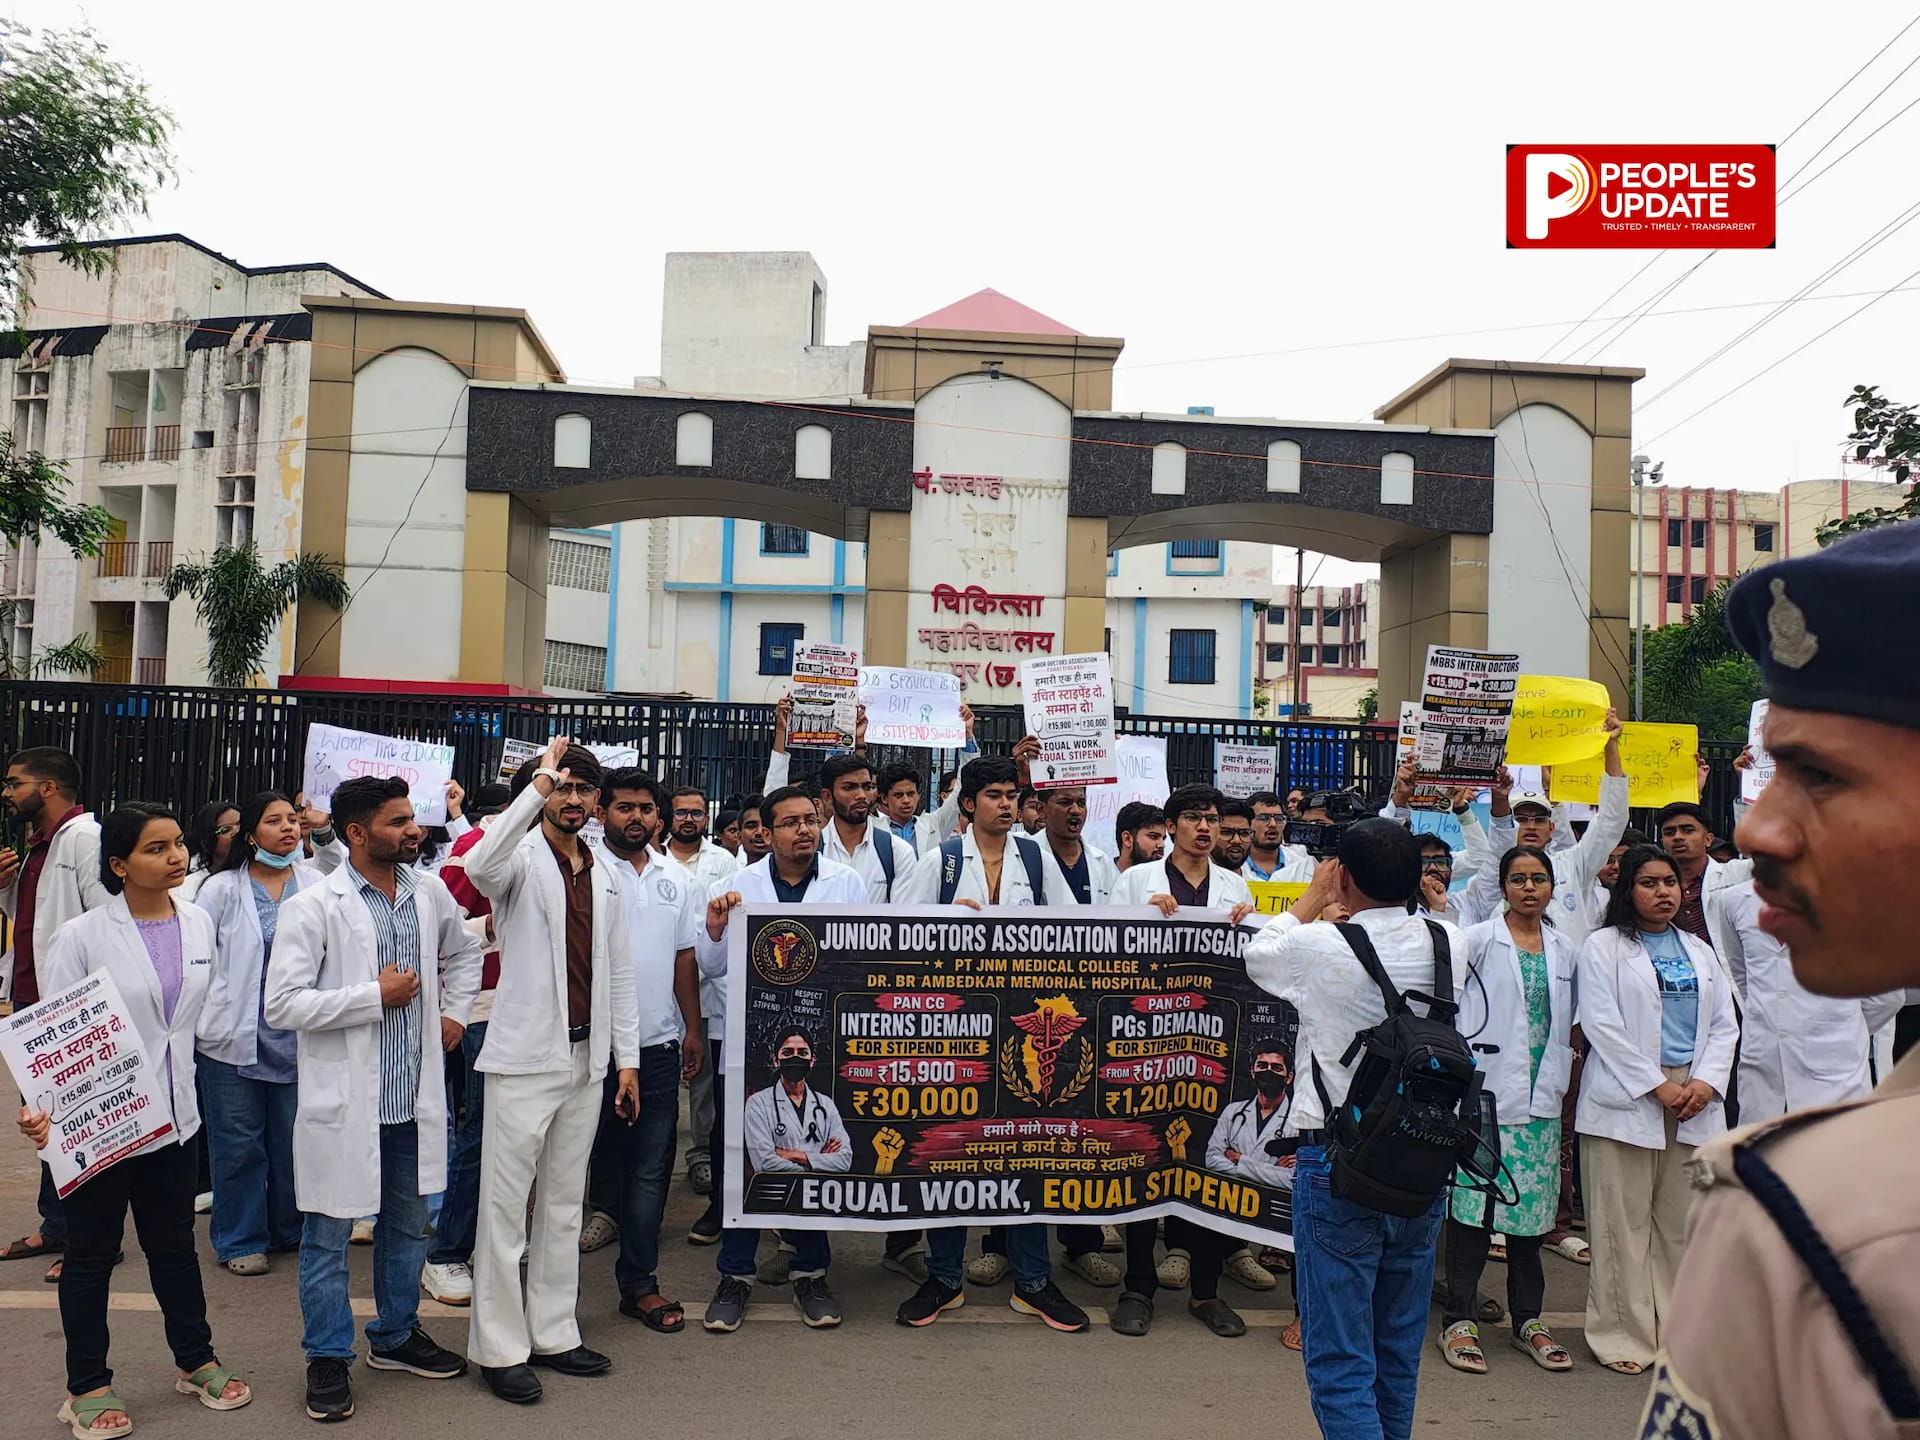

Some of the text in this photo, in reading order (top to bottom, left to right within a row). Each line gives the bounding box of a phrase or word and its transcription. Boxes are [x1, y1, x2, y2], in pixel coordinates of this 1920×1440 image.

[931, 583, 1045, 617] चिकित्सा
[918, 621, 1055, 653] महाविद्यालय
[1430, 656, 1520, 672] MBBS INTERN DOCTORS
[1034, 672, 1096, 686] हमारी एक ही मांग
[1431, 676, 1514, 692] ₹15,900 ₹30,000
[1032, 689, 1056, 702] उचित
[1058, 685, 1090, 700] स्टाइपेंड
[1517, 689, 1546, 699] erve
[1046, 700, 1094, 715] सम्मान दो!
[1512, 704, 1586, 719] We Learn
[1048, 718, 1107, 730] ₹15,900 ₹30,000
[1428, 713, 1506, 726] शांतिपूर्ण पैदल मार्च
[1530, 723, 1602, 740] We Deser
[1044, 740, 1101, 751] EQUAL WORK,
[1040, 749, 1107, 762] EQUAL STIPEND!
[1222, 754, 1244, 764] हमारी
[1759, 770, 1775, 779] EQU
[944, 854, 957, 884] safari
[1268, 896, 1299, 912] TIM
[820, 922, 892, 950] JUNIOR
[899, 923, 987, 952] DOCTORS
[992, 924, 1119, 954] ASSOCIATION
[954, 958, 1139, 974] PT JNM MEDICAL COLLEGE
[868, 974, 1213, 992] DR. BR AMBEDKAR MEMORIAL HOSPITAL, RAIPUR
[760, 992, 776, 1002] FAIR
[794, 989, 823, 1000] RESPECT
[893, 996, 945, 1010] PAN CG
[1148, 996, 1190, 1010] PAN CG
[10, 978, 101, 1030] JUNIOR DOCTORS ASSOCIATION
[37, 996, 89, 1027] CHHATTISGARH
[753, 1000, 780, 1012] STIPEND
[792, 1006, 822, 1016] SERVICE
[1256, 1004, 1270, 1014] WE
[24, 1000, 108, 1054] हमारी एक ही मांग
[841, 1012, 993, 1037] INTERNS DEMAND
[1112, 1011, 1224, 1038] PGs DEMAND
[1250, 1014, 1276, 1024] SERVE
[27, 1014, 126, 1080] उचित स्टाइपेंड दो,
[856, 1041, 980, 1054] FOR STIPEND HIKE
[1115, 1038, 1220, 1056] FOR STIPEND HIKE
[52, 1042, 118, 1086] सम्मान दो!
[848, 1060, 973, 1085] FROM ₹15,900 TO
[1106, 1056, 1212, 1082] FROM ₹67,000 TO
[62, 1055, 140, 1106] ₹15,900 ₹30,000
[852, 1086, 978, 1120] ₹30,000
[1106, 1081, 1218, 1116] ₹1,20,000
[62, 1086, 139, 1136] EQUAL WORK,
[60, 1094, 150, 1154] EQUAL STIPEND!
[983, 1122, 1079, 1138] हमारी मांगे एक है
[964, 1137, 1112, 1156] सम्मान कार्य के लिए
[928, 1152, 1146, 1174] सम्मान एवं सम्मानजनक स्टाइपेंड
[802, 1170, 1261, 1218] EQUAL WORK, EQUAL STIPEND
